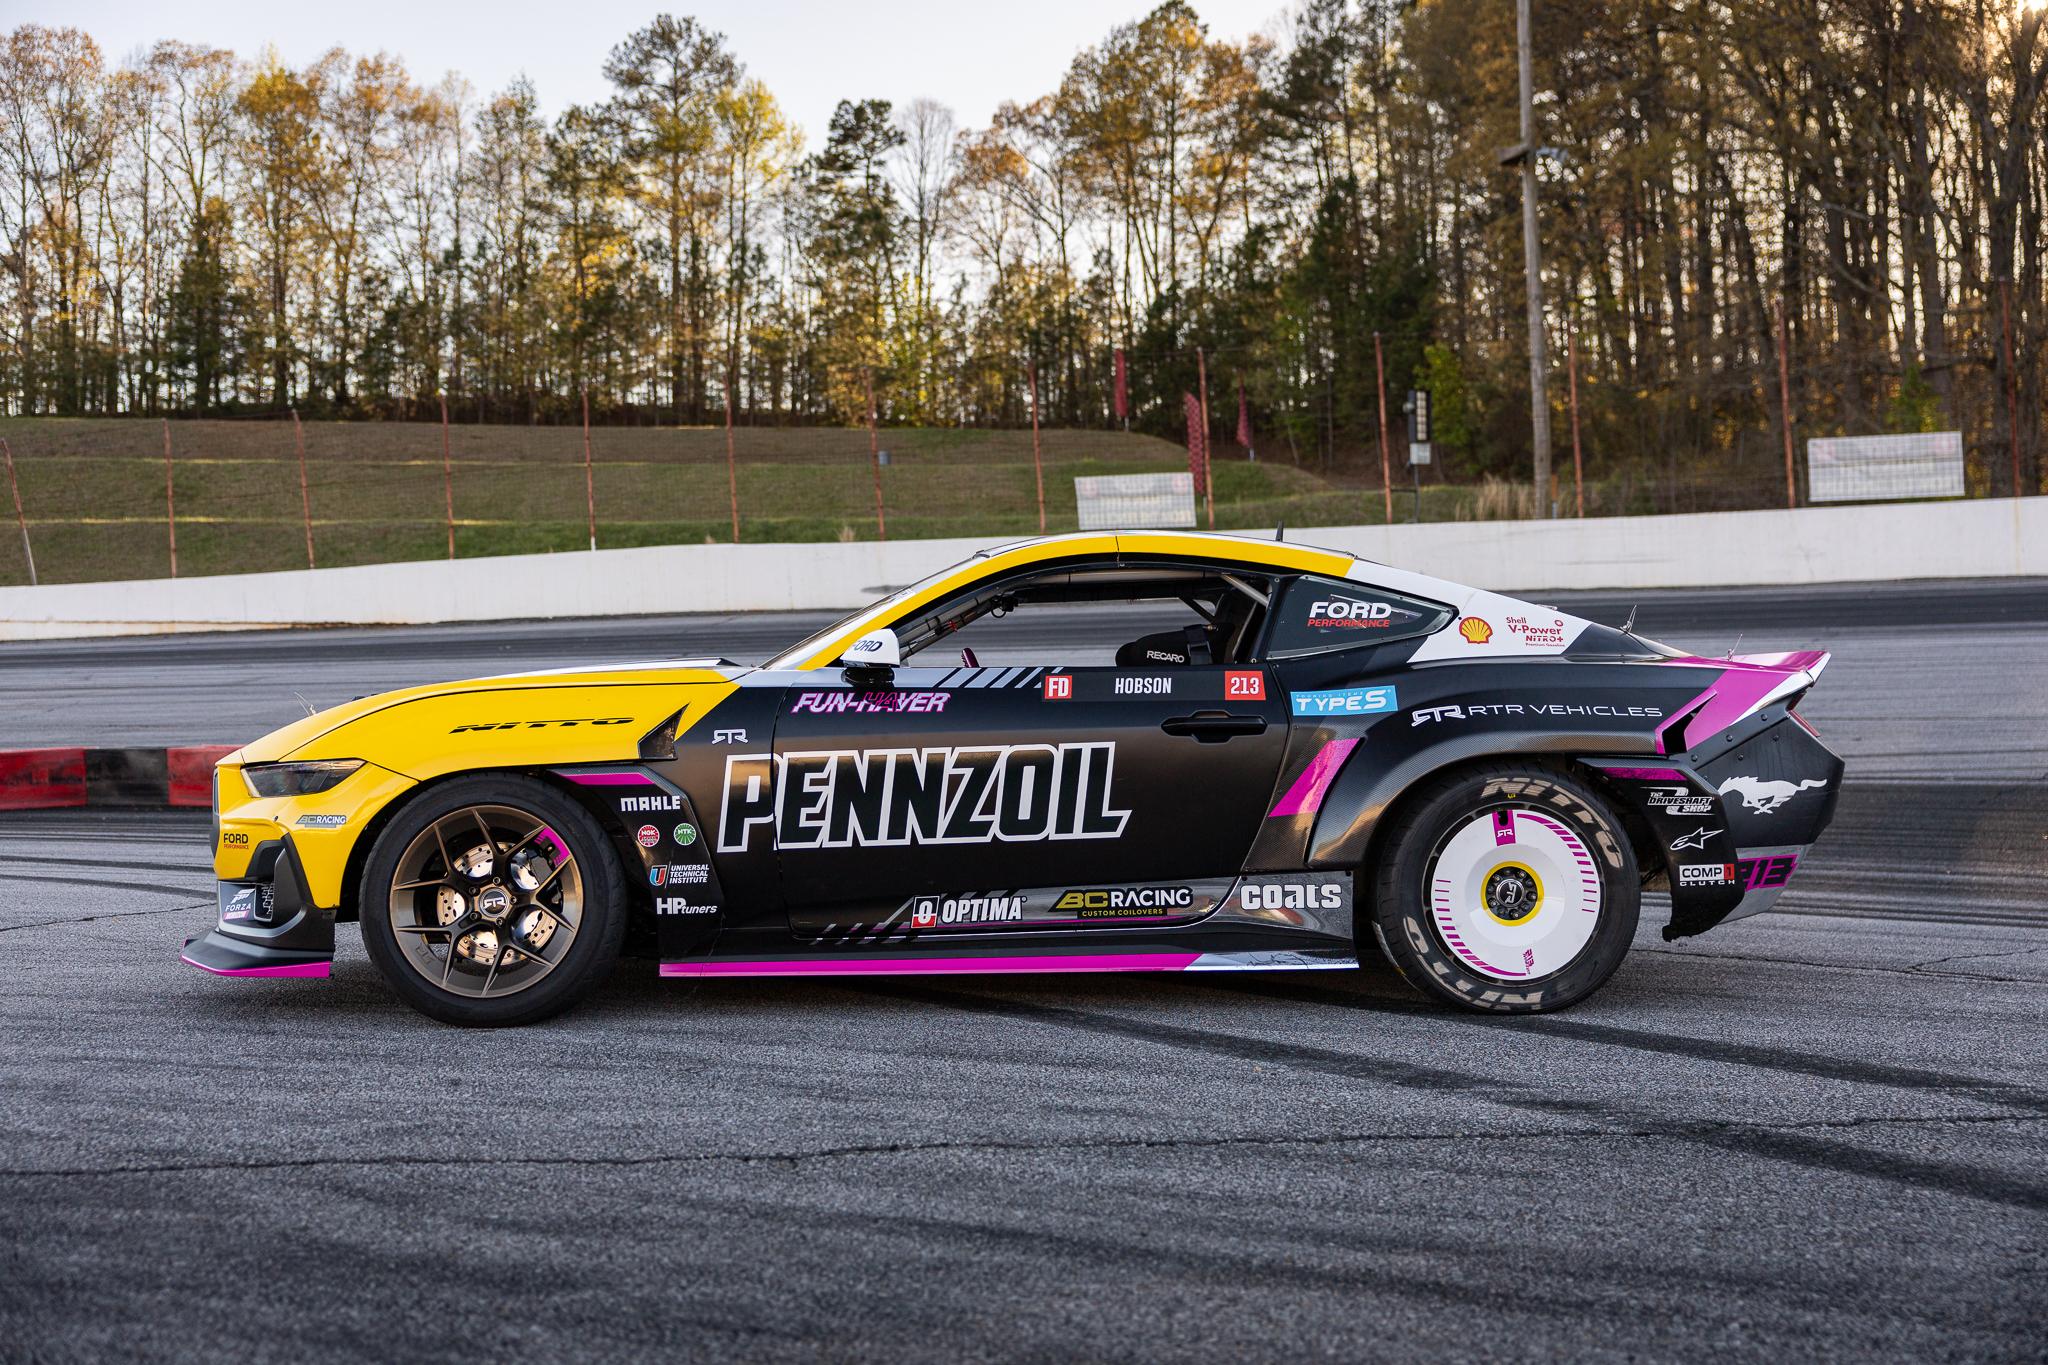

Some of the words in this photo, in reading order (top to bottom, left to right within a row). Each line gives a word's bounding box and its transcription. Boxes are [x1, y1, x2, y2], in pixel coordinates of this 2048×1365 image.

[1309, 602, 1392, 619] FORD
[1307, 619, 1391, 628] PERFORMANCE
[1506, 616, 1526, 624] Shell
[1508, 624, 1562, 635] V-Power
[1146, 650, 1185, 663] RECARO
[1047, 677, 1070, 697] FD
[1114, 677, 1172, 694] HOBSON
[1230, 677, 1260, 695] 213
[1468, 705, 1525, 716] RTR
[1529, 705, 1663, 717] VEHICLES
[716, 741, 1133, 853] PENNZOIL
[1648, 797, 1712, 806] DRIVESHAFT
[620, 796, 681, 812] MAHLE
[1682, 805, 1712, 813] SHOP
[316, 815, 346, 824] RACING
[223, 833, 249, 844] FORD
[1110, 888, 1191, 908] RACING
[225, 902, 252, 912] FORZA
[940, 897, 1023, 923] OPTIMA
[1082, 910, 1116, 918] CUSTOM
[1121, 908, 1164, 916] COILOVERS
